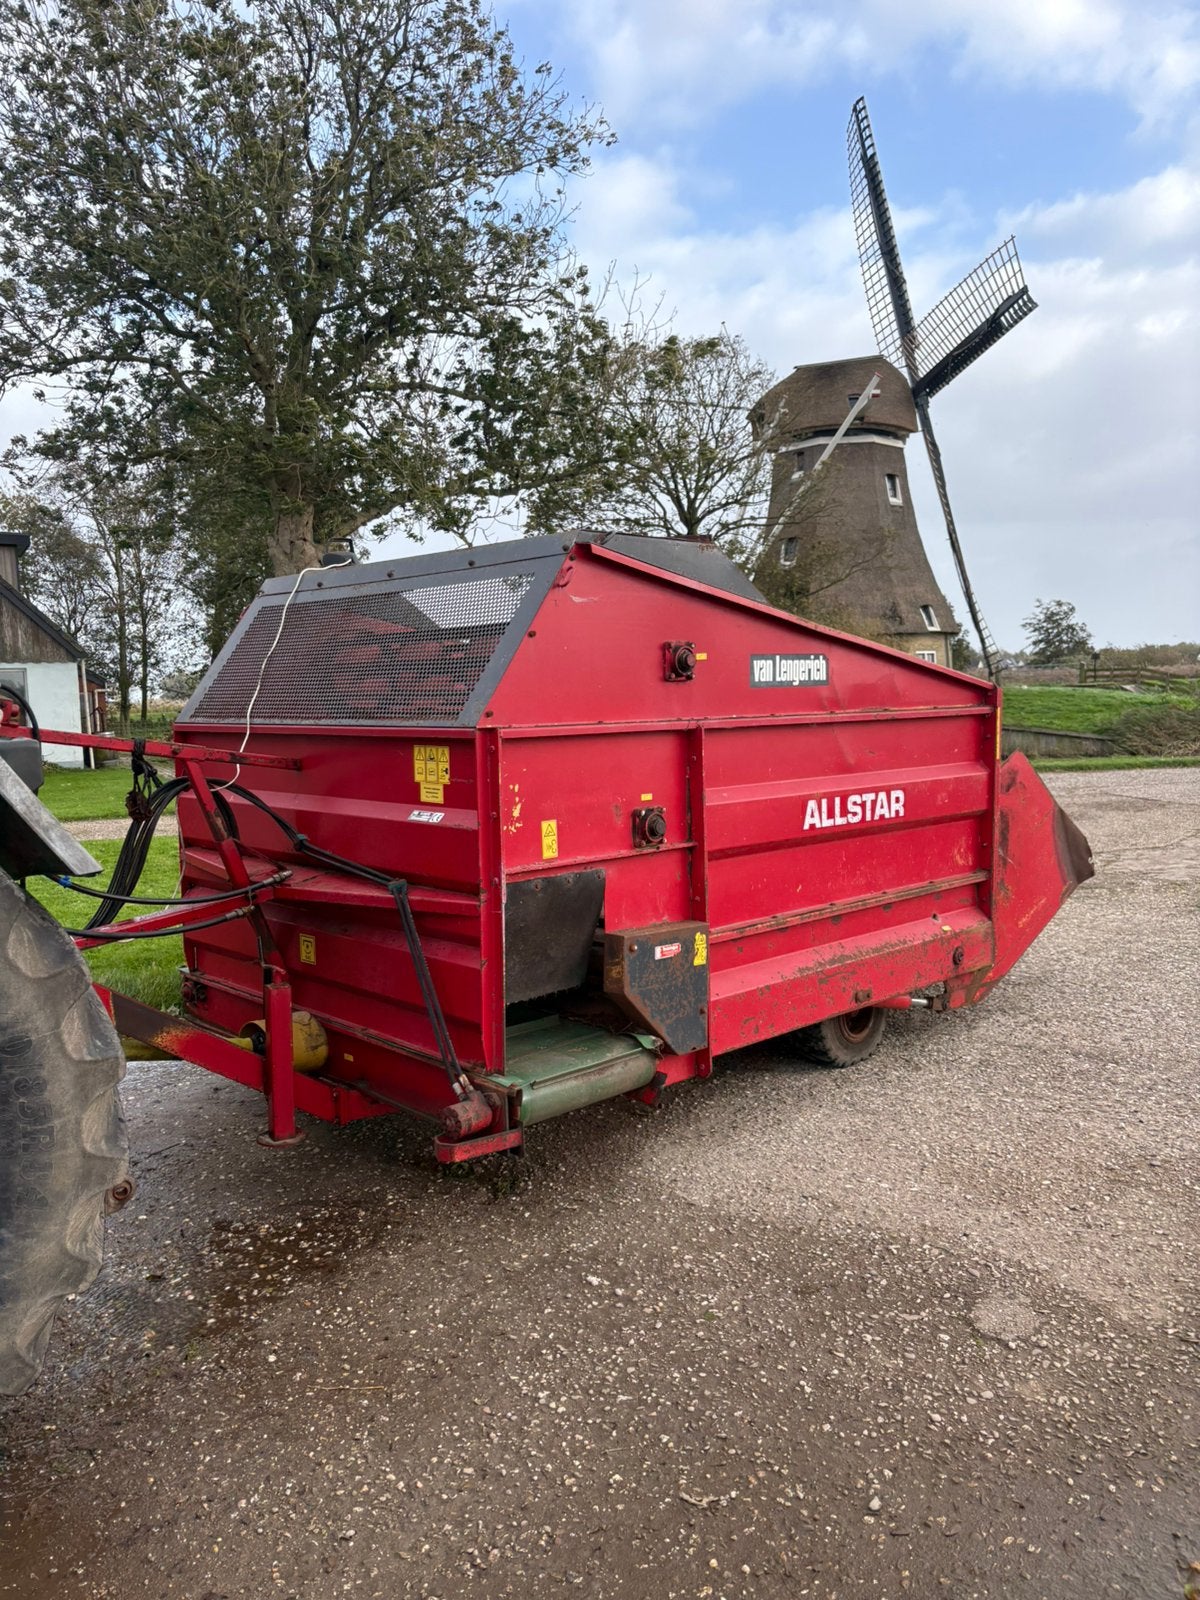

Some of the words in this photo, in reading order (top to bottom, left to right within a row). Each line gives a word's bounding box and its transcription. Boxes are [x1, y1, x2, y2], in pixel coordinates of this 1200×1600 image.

[753, 659, 773, 682] van
[776, 655, 826, 686] Lengerich
[803, 790, 905, 830] ALLSTAR
